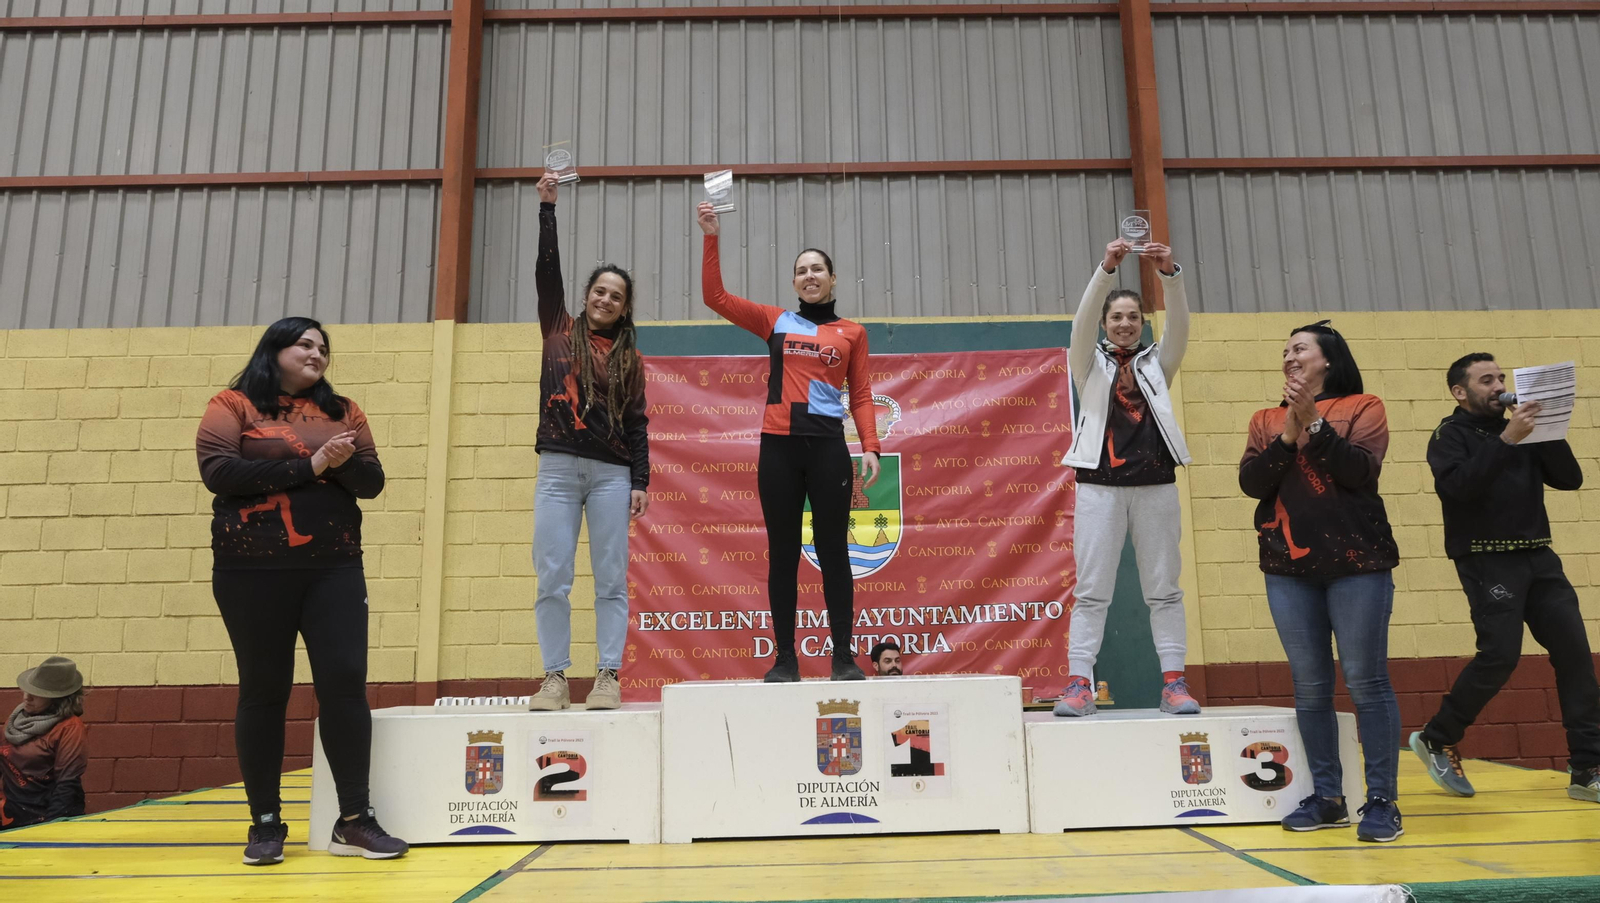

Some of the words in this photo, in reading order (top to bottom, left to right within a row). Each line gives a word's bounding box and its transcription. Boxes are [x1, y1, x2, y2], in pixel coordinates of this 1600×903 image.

[785, 341, 820, 352] TRI
[644, 373, 687, 383] TORIA
[720, 374, 755, 383] AYTO.
[868, 372, 894, 381] YTO.
[901, 370, 966, 380] CANTORIA
[998, 366, 1033, 377] AYTO.
[650, 404, 685, 414] AYTO.
[692, 404, 758, 415] CANTORIA
[931, 400, 966, 410] AYTO.
[973, 397, 1037, 407] CANTORIA
[649, 432, 686, 441] TORIA
[720, 431, 755, 440] AYTO.
[904, 424, 970, 435] CANTORIA
[1002, 424, 1036, 434] AYTO.
[650, 464, 685, 474] AYTO.
[692, 462, 758, 473] CANTORIA
[934, 458, 968, 468] AYTO.
[975, 456, 1041, 467] CANTORIA
[1296, 454, 1326, 494] OLVORA
[649, 492, 687, 501] TORIA
[720, 490, 756, 500] AYTO.
[906, 485, 972, 496] CANTORIA
[1005, 483, 1040, 493] AYTO.
[649, 524, 685, 534] AYTO.
[692, 523, 759, 534] CANTORIA
[936, 518, 971, 528] AYTO.
[978, 516, 1044, 527] CANTORIA
[630, 552, 687, 562] ANTORIA
[721, 552, 756, 561] AYTO.
[908, 546, 975, 557] CANTORIA
[1009, 544, 1043, 554] AYTO.
[649, 586, 685, 596] AYTO.
[692, 584, 760, 595] CANTORIA
[853, 582, 906, 592] NTORIA
[939, 580, 975, 589] AYTO.
[982, 577, 1048, 588] CANTORIA
[638, 609, 830, 631] EXCELENTIM
[855, 600, 1063, 627] AYUNTAMIENTO
[649, 648, 686, 658] AYTO.
[692, 648, 751, 659] CANTORI
[951, 642, 978, 652] YTO.
[985, 638, 1052, 650] CANTORIA
[753, 636, 776, 658] D
[1017, 667, 1052, 677] AYTO.
[1240, 741, 1293, 791] 3
[533, 751, 587, 801] 2
[797, 779, 880, 793] DIPUTACIÓN
[1171, 787, 1226, 798] DIPUTACIÓN
[448, 799, 518, 812] DIPUTACIÓN
[800, 797, 817, 807] DE
[821, 794, 878, 807] ALMERÍA
[1173, 800, 1186, 808] DE
[1188, 798, 1226, 808] ALMERÍA
[450, 814, 464, 823] DE
[467, 812, 516, 823] ALMERÍA
